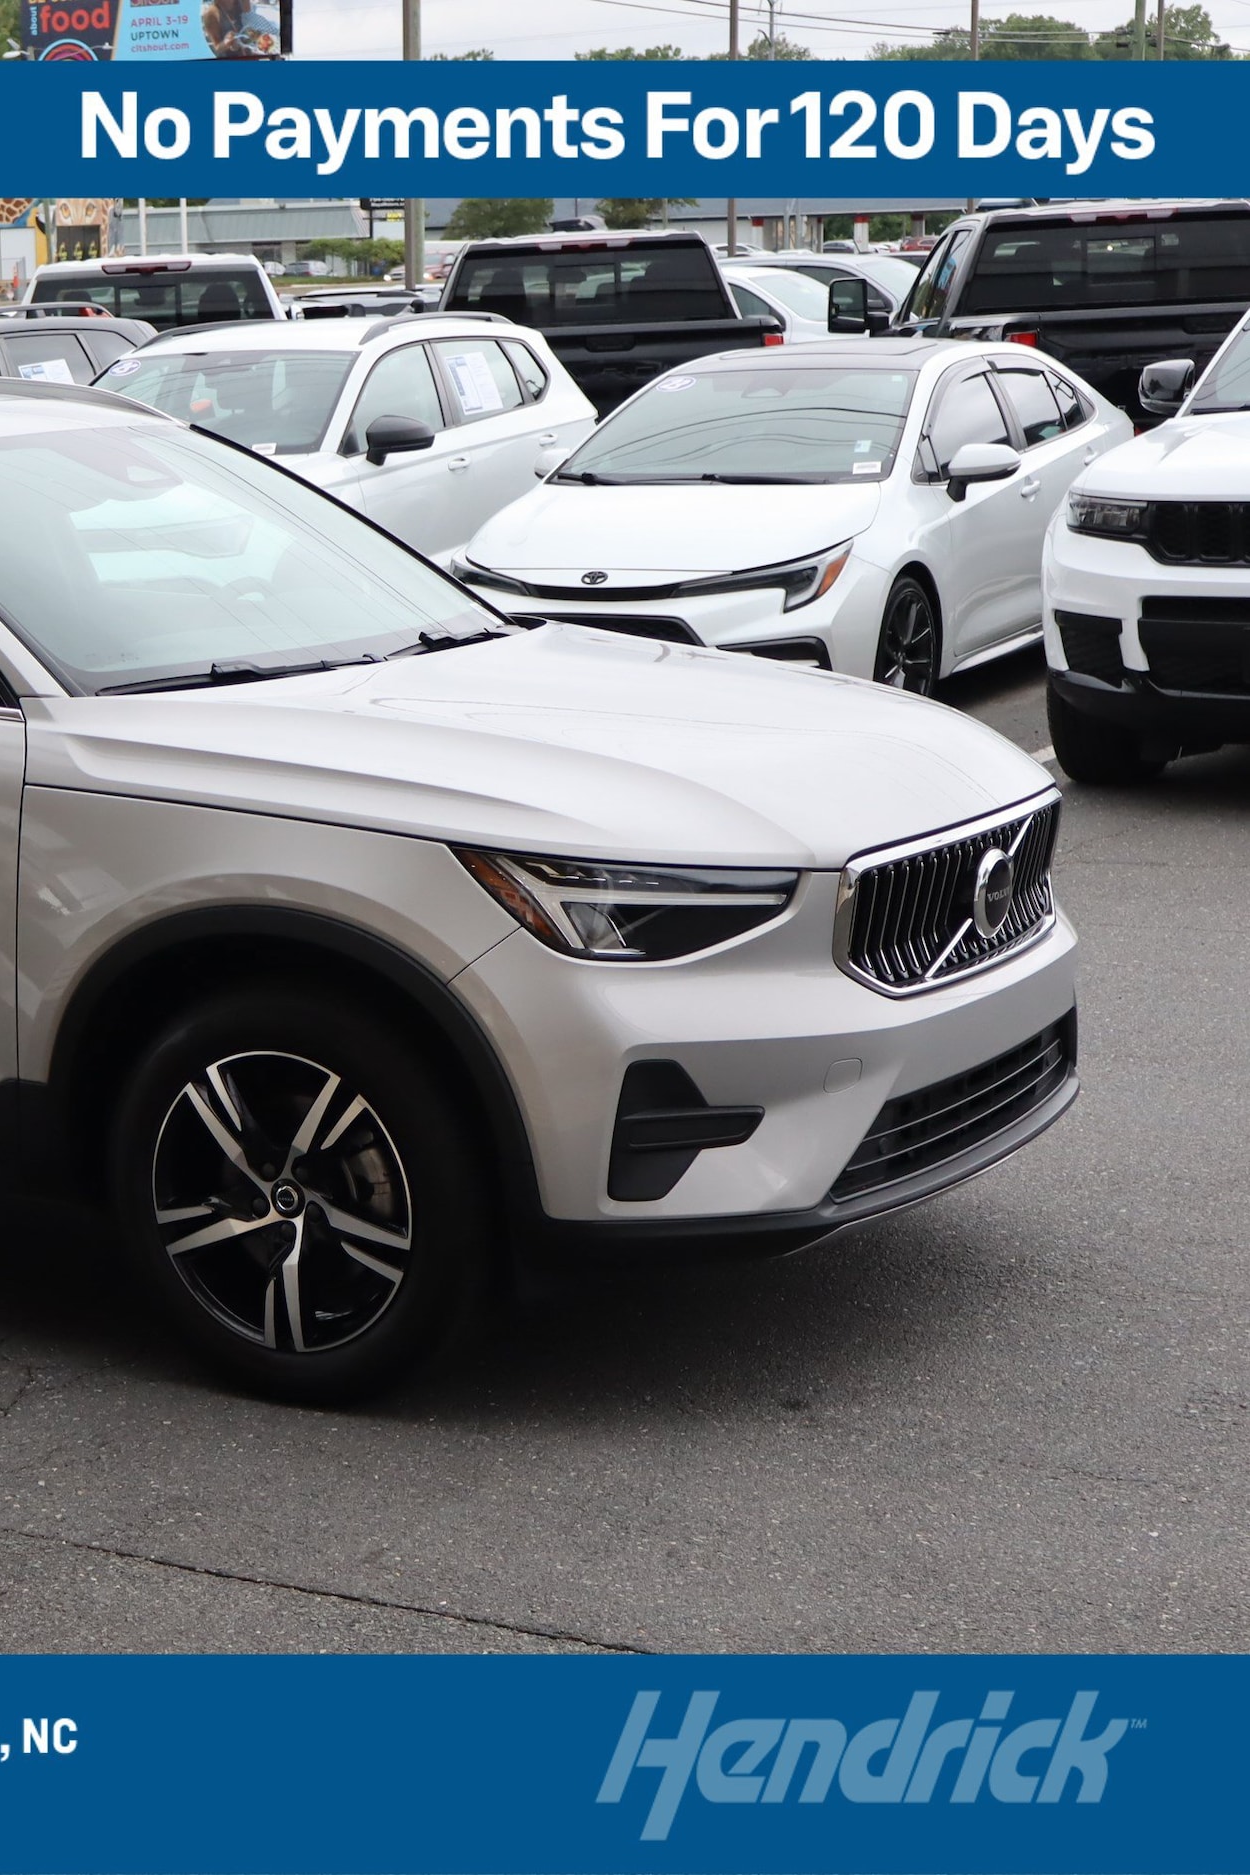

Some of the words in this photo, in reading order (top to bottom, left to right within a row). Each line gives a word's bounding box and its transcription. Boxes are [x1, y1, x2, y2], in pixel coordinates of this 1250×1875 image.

[29, 6, 38, 36] about
[40, 1, 110, 33] food
[131, 17, 162, 28] APRIL
[166, 14, 189, 26] 3-19
[130, 29, 179, 41] UPTOWN
[130, 42, 190, 53] cltshout.com
